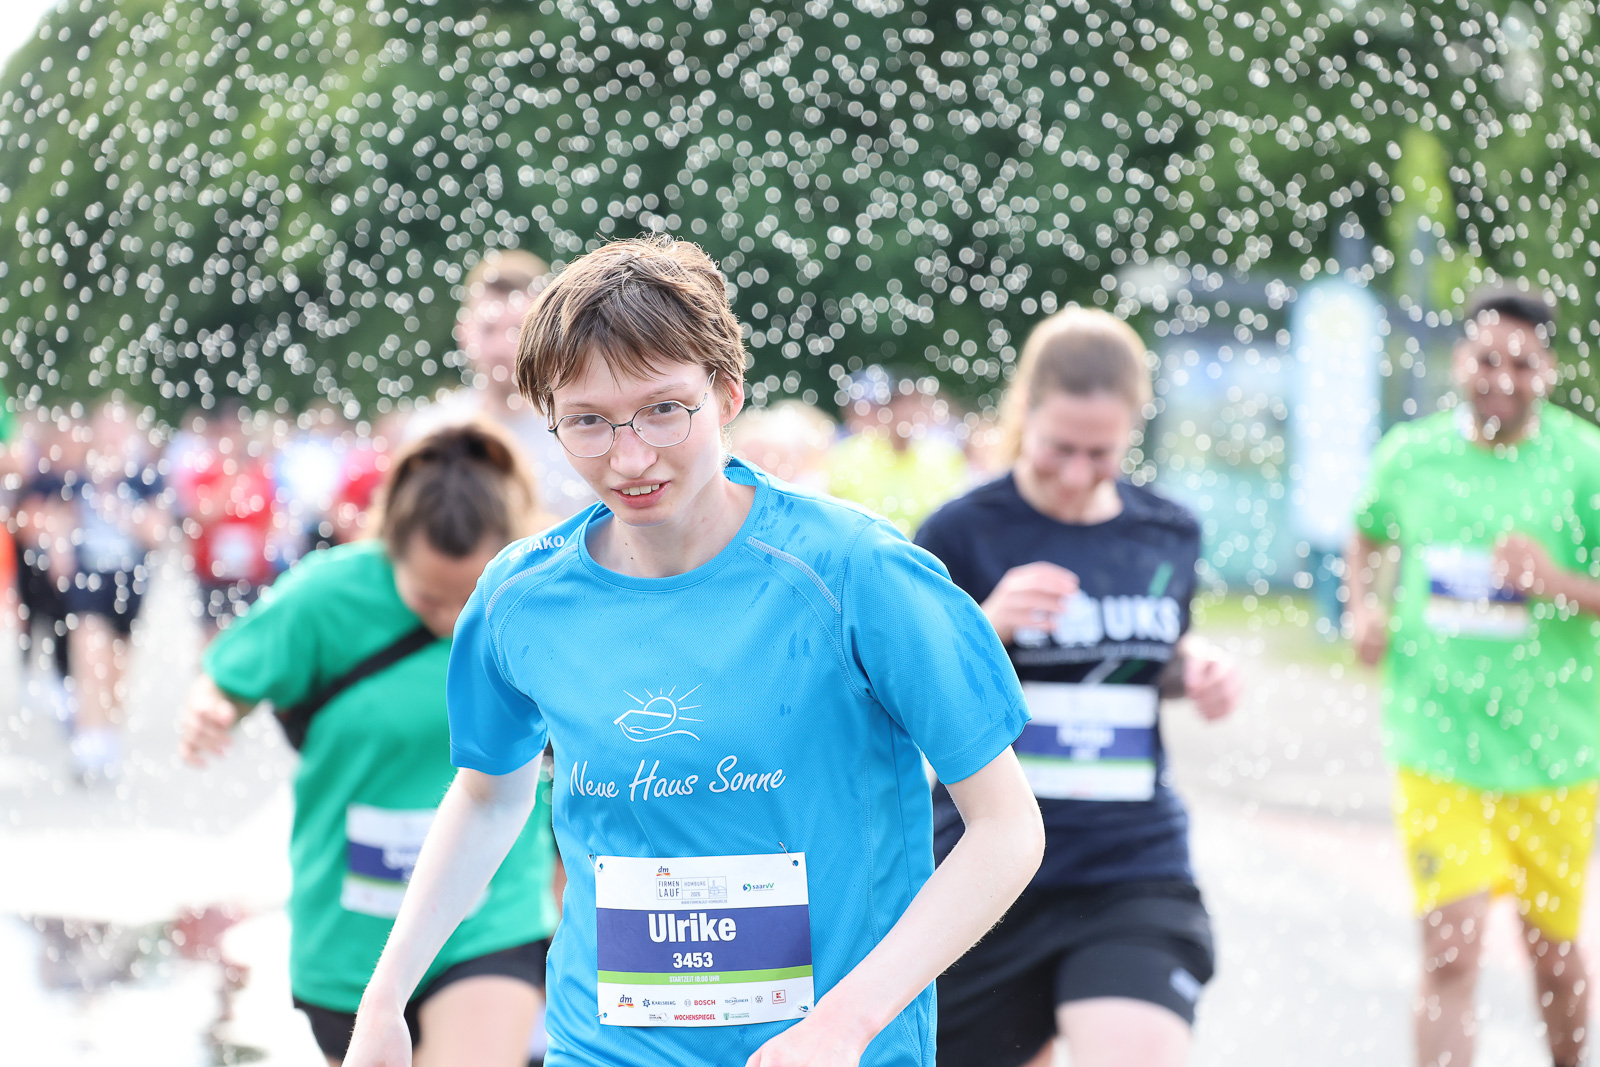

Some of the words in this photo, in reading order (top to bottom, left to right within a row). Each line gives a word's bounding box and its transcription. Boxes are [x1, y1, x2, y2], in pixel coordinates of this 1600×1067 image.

[526, 534, 566, 553] JAKO
[1102, 595, 1181, 644] UKS
[569, 760, 620, 798] Neue
[628, 759, 699, 802] Haus
[708, 754, 787, 793] Sonne
[657, 865, 669, 873] dm
[658, 888, 680, 898] LAUF
[648, 912, 737, 943] Ulrike
[672, 951, 714, 969] 3453
[669, 975, 694, 983] STARTZEIT
[709, 974, 720, 982] UHR
[619, 994, 632, 1003] dm
[673, 1013, 716, 1021] WOCHENSPIEGEL
